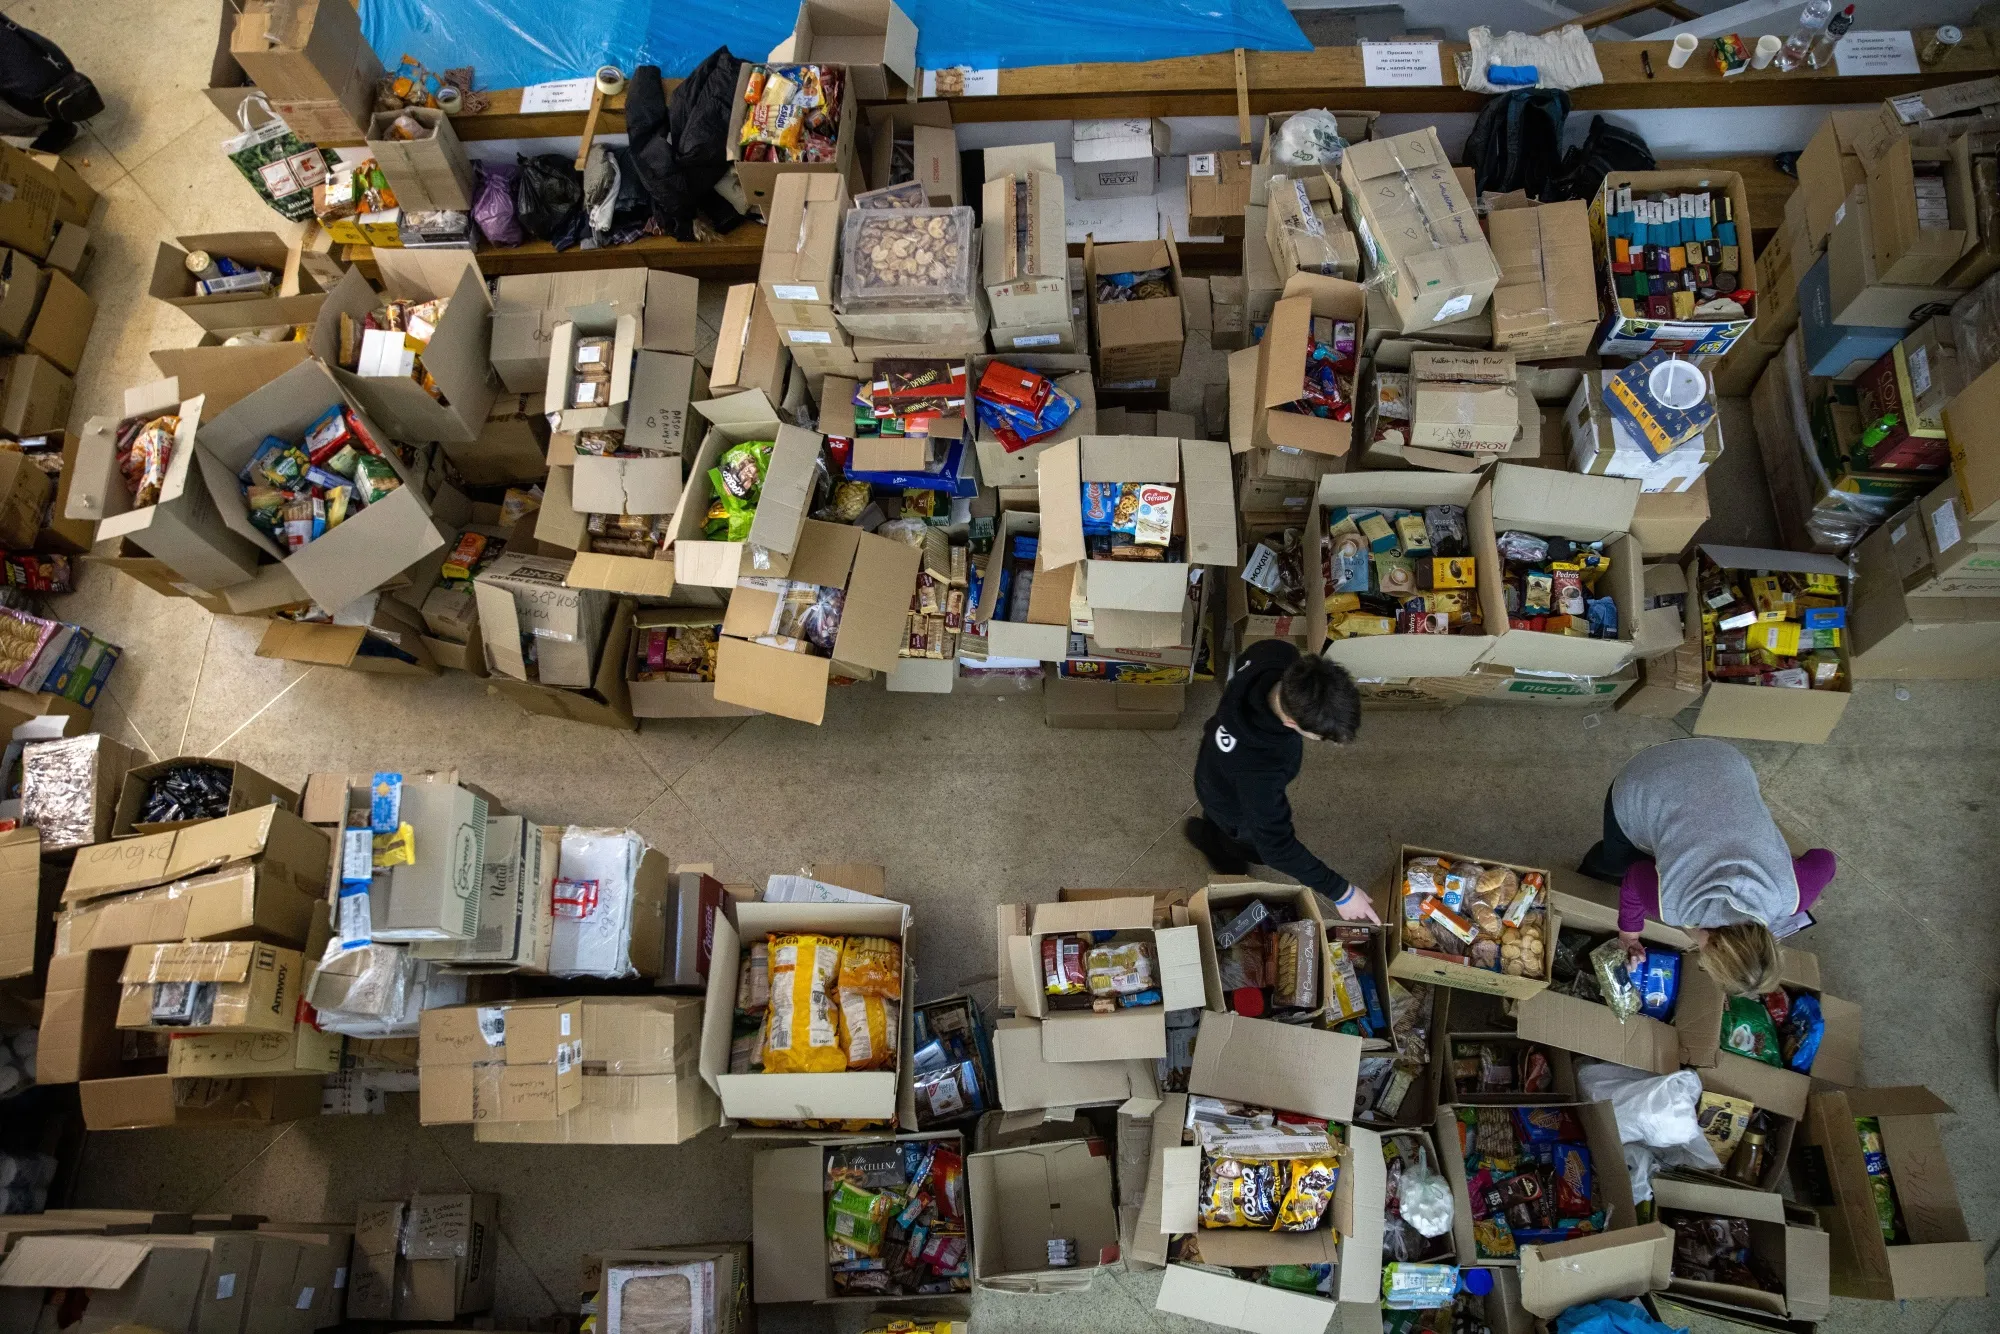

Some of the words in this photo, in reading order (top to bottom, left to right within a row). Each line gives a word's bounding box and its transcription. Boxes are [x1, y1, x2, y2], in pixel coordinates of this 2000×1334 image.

[1250, 550, 1271, 582] MOKATE
[1555, 571, 1580, 579] Pedro's
[773, 938, 799, 947] MEGA
[854, 1161, 896, 1171] EXCELLENZ
[1242, 1168, 1255, 1216] CHOCO
